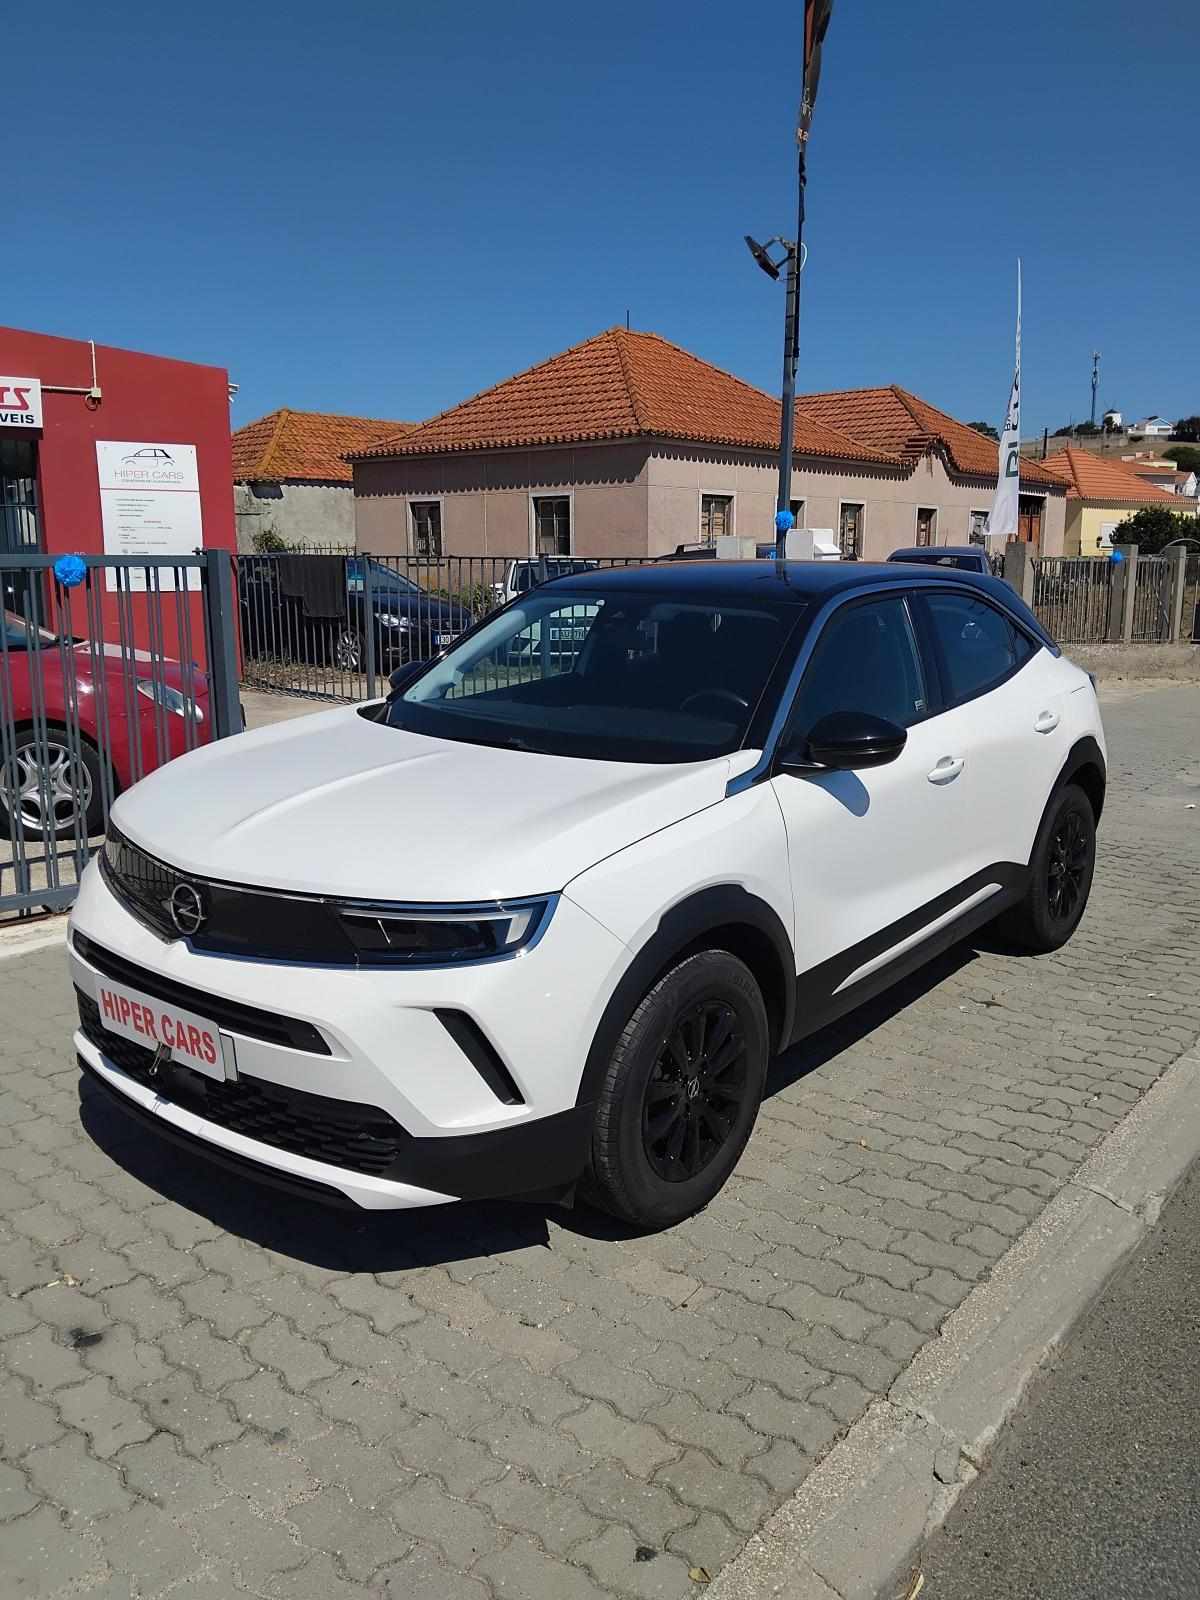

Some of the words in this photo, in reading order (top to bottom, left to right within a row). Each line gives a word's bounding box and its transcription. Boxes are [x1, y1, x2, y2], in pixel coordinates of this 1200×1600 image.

[114, 469, 148, 480] HIPER
[152, 471, 184, 480] CARS
[101, 988, 157, 1039] HIPER
[161, 1014, 216, 1064] CARS
